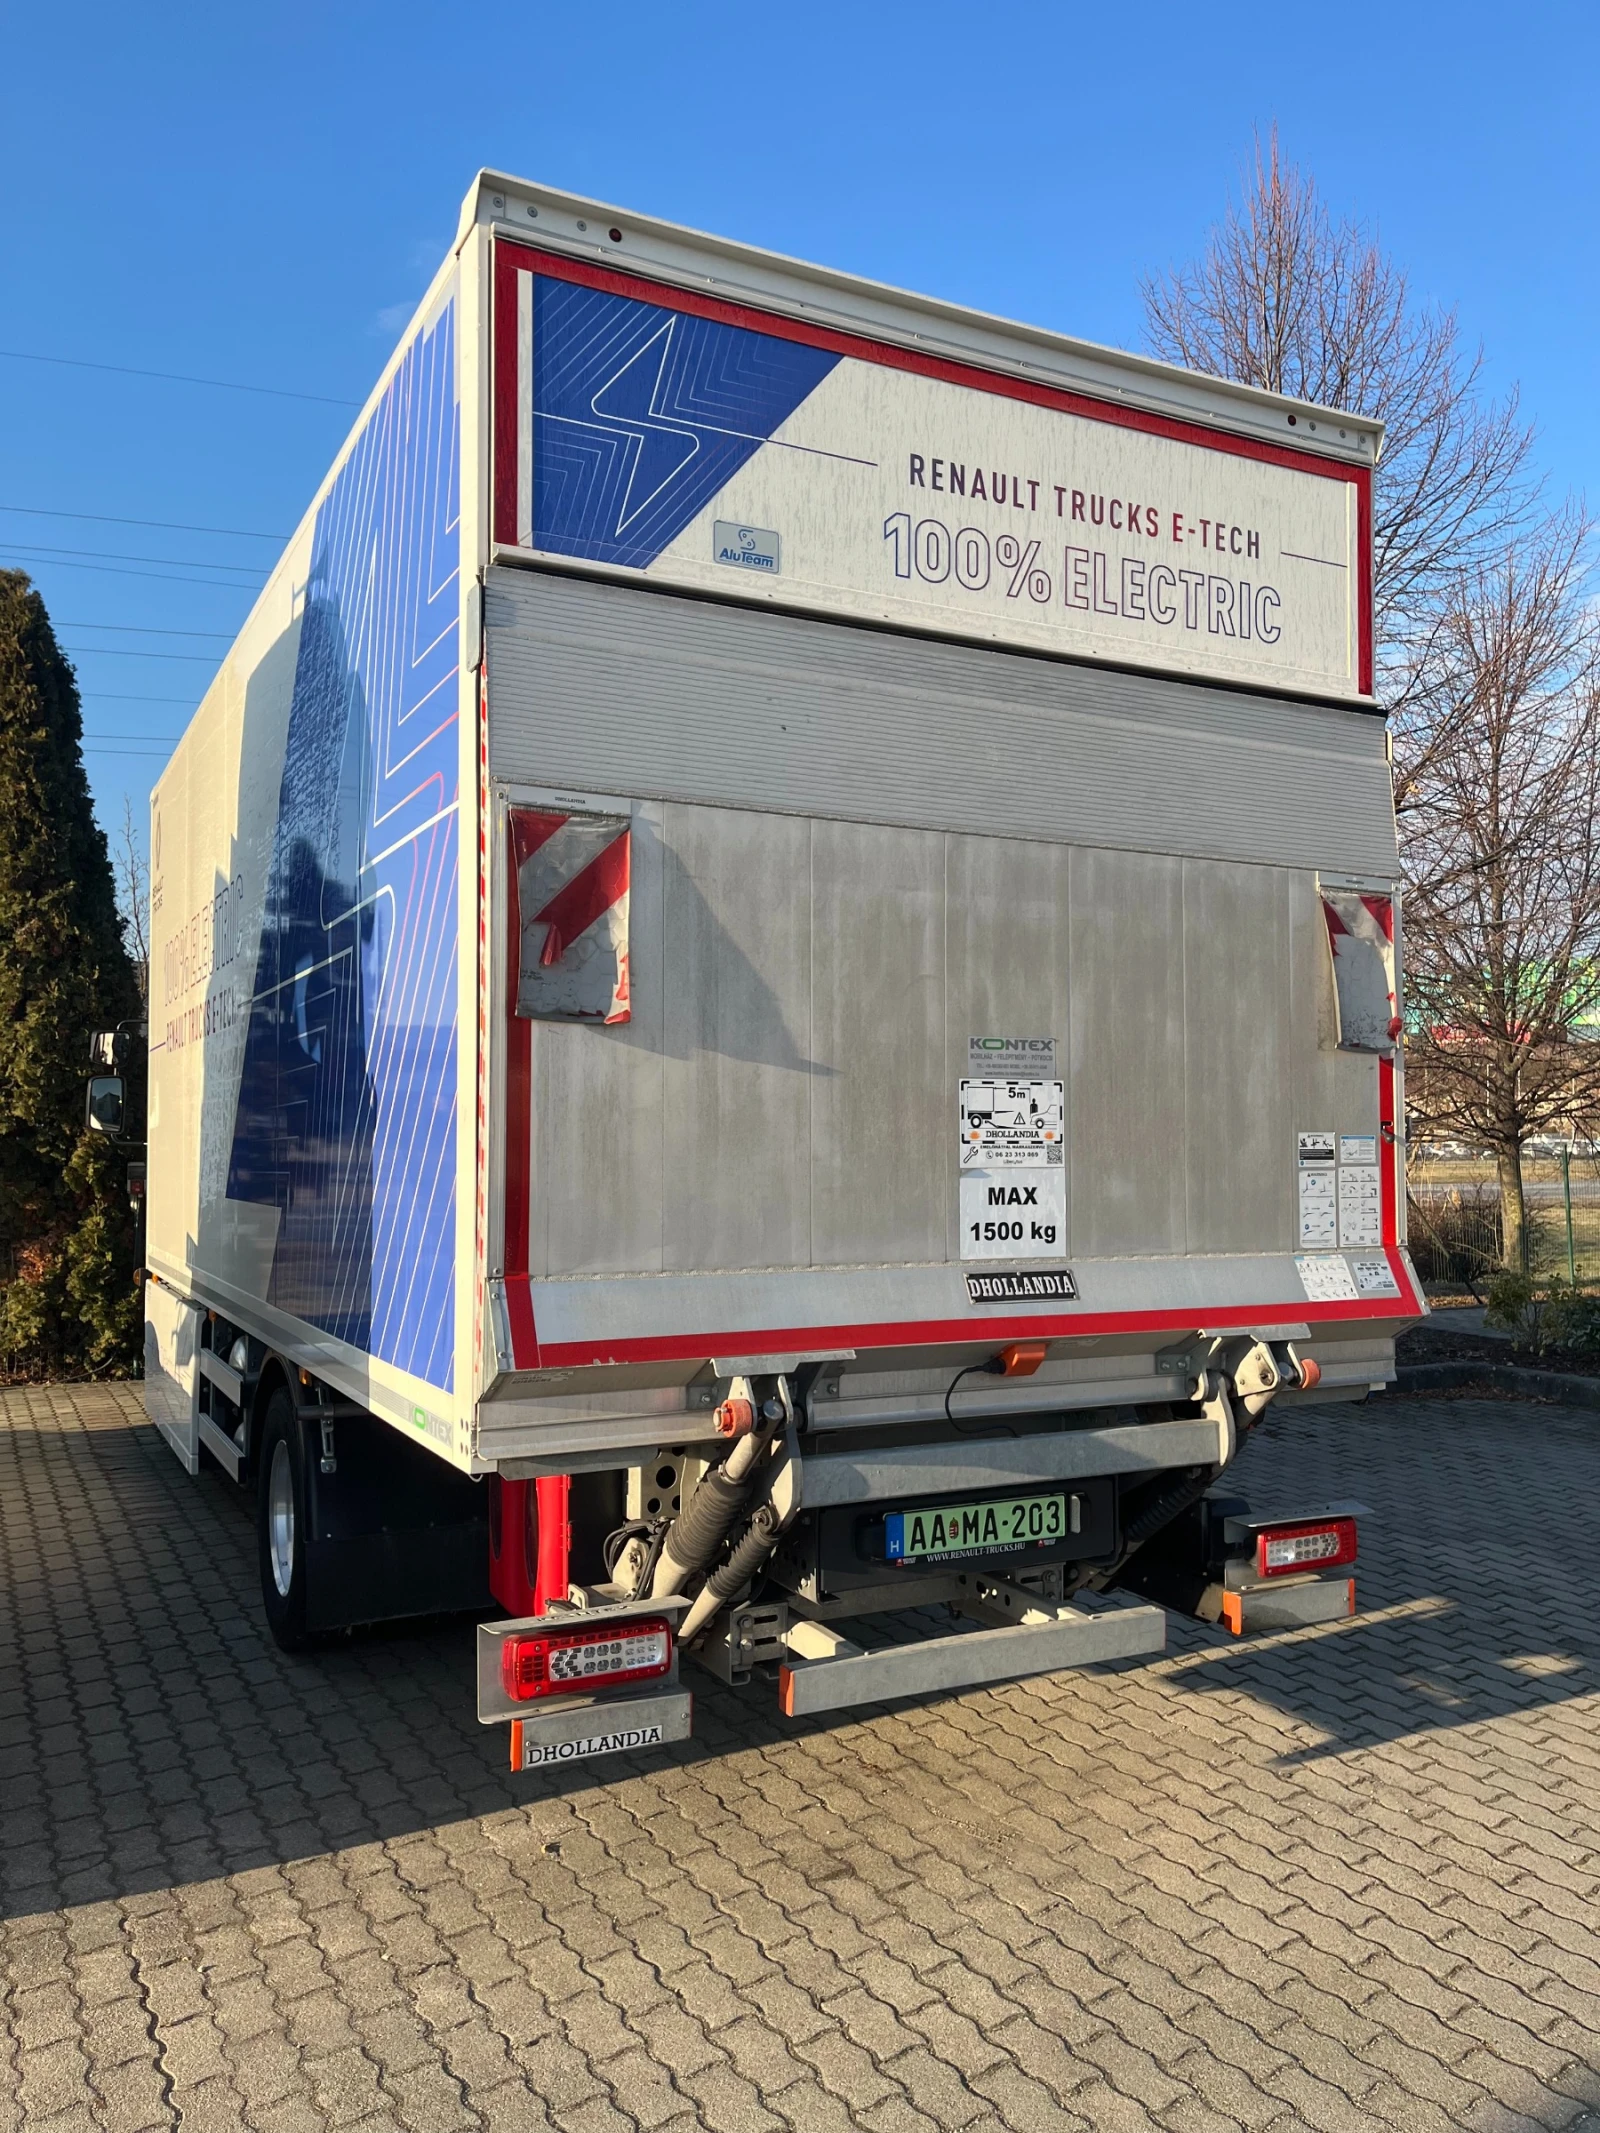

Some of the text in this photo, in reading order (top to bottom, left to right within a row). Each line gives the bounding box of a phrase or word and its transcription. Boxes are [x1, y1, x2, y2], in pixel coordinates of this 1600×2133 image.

[909, 454, 1261, 560] RENAULT TRUCKS E-TECH
[719, 548, 774, 568] AluTeam
[884, 512, 1282, 645] 100% ELECTRIC
[190, 874, 244, 989] ELECTRIC
[970, 1038, 1053, 1051] KONTEX
[986, 1130, 1040, 1139] DHOLLANDIA
[988, 1187, 1038, 1206] MAX
[970, 1221, 1056, 1243] 1500 kg
[968, 1275, 1075, 1298] DHOLLANDIA
[910, 1514, 947, 1552] AA
[890, 1540, 900, 1553] H
[926, 1542, 1026, 1563] WWW.RENAULT-TRUCKS.HU
[527, 1727, 661, 1765] DHOLLANDIA
